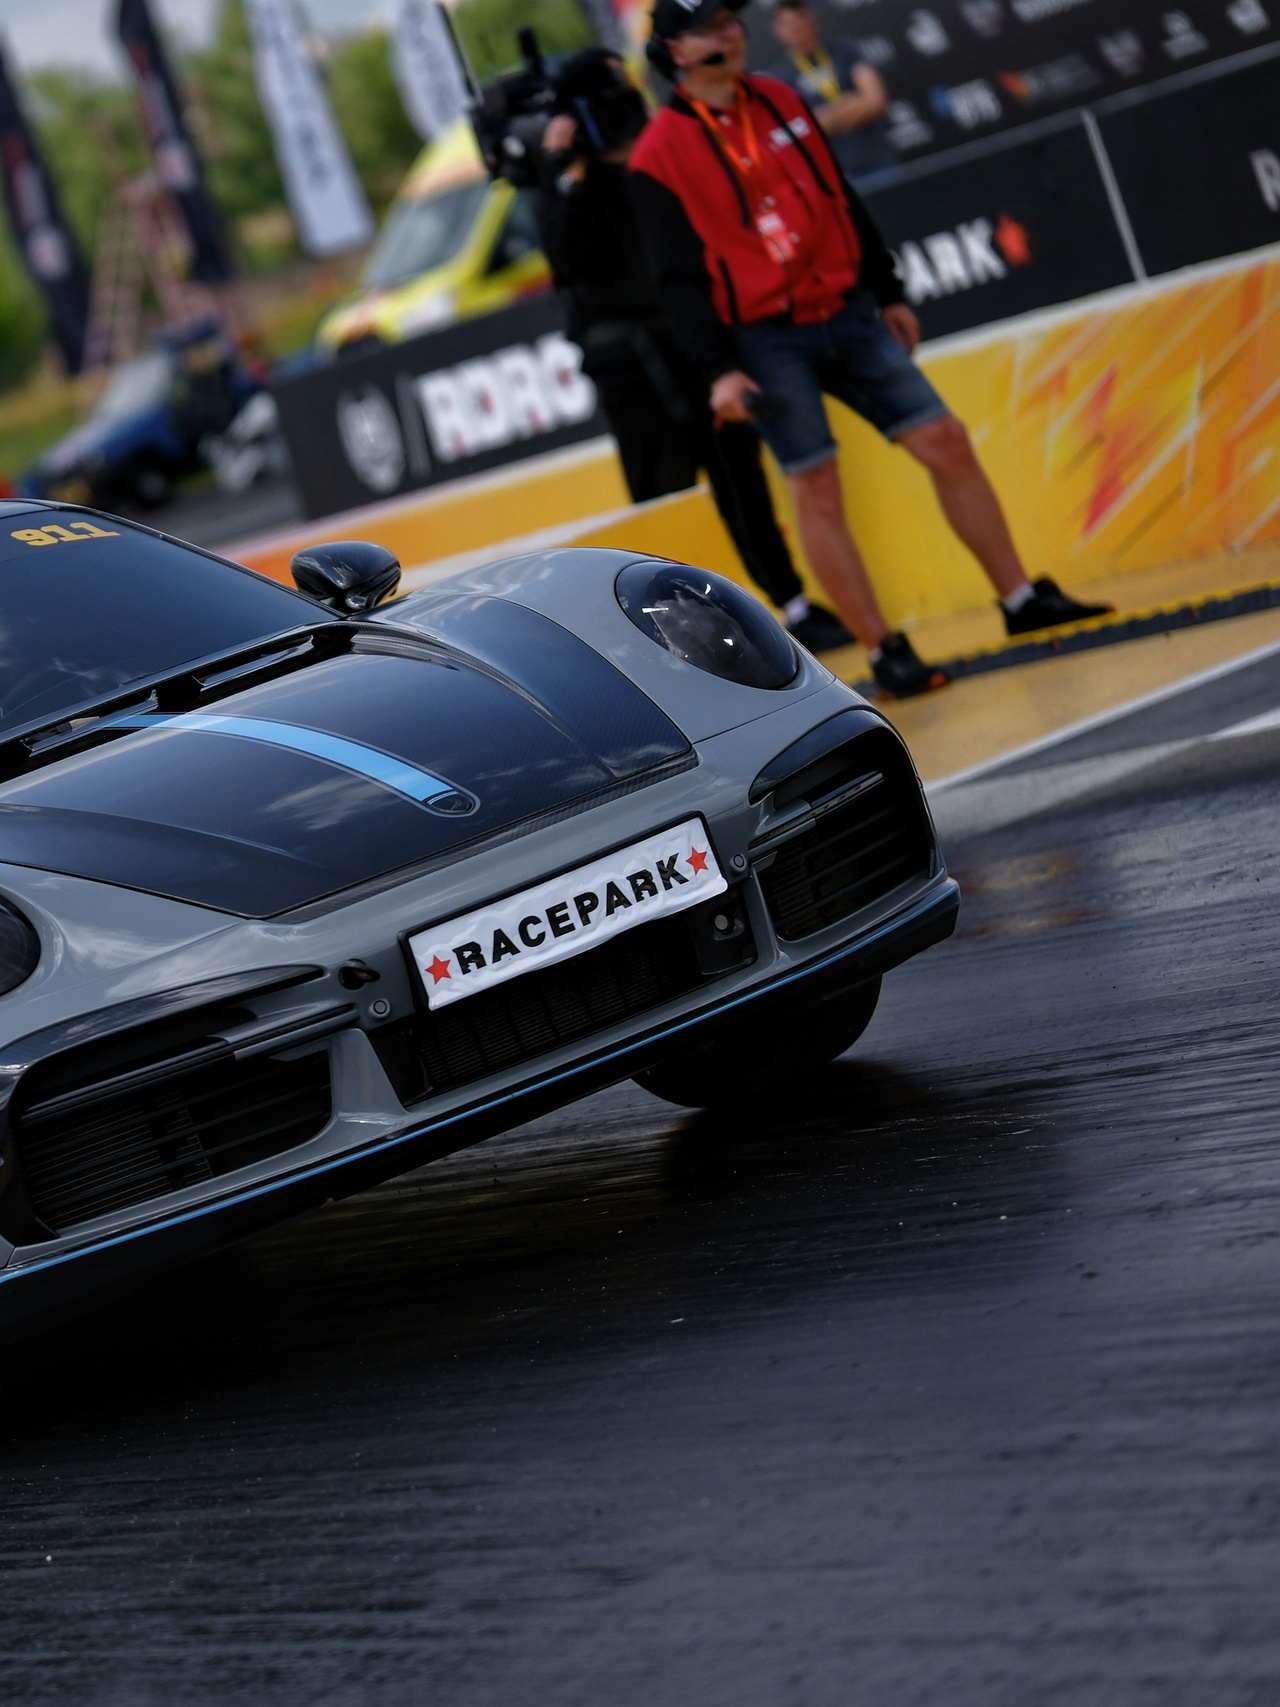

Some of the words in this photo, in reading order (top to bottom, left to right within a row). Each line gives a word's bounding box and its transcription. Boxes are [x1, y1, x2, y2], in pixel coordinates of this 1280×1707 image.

[888, 216, 1006, 306] ARK
[10, 521, 121, 546] 911
[452, 852, 690, 975] RACEPARK
